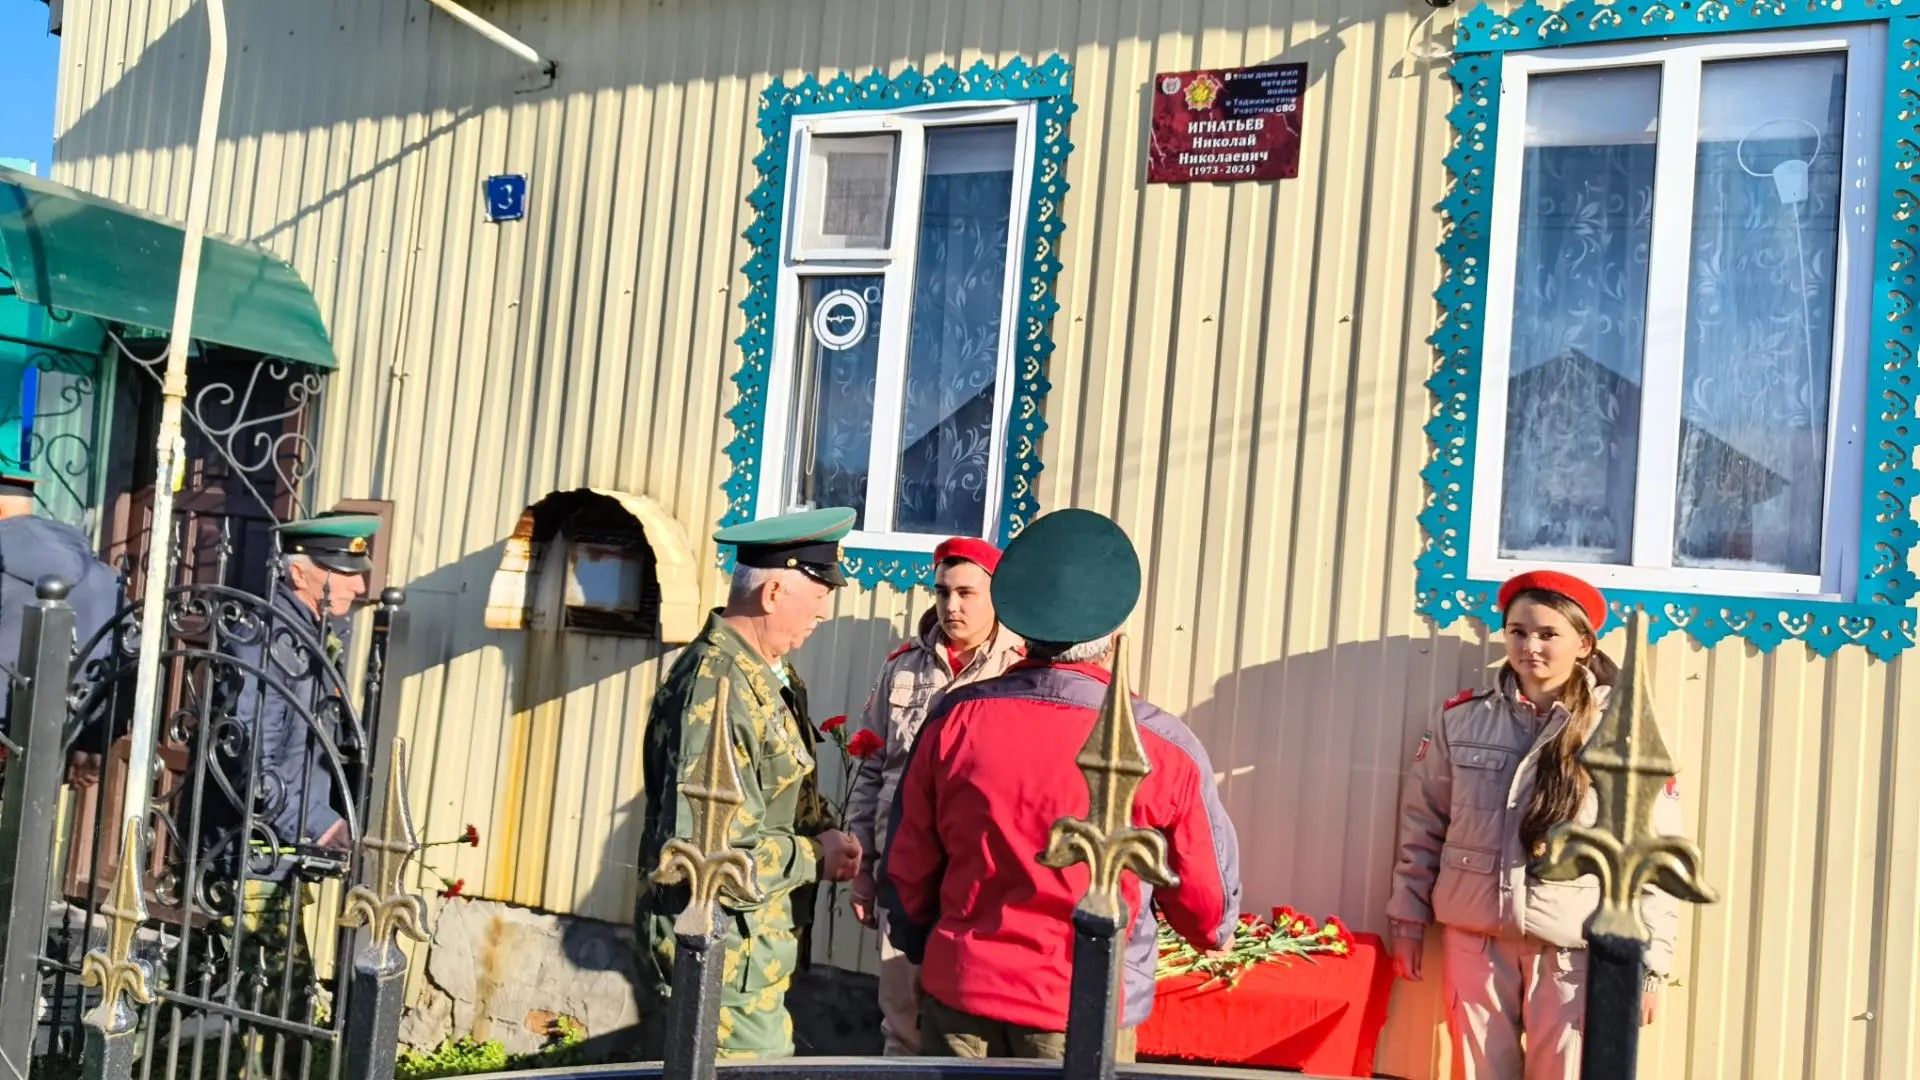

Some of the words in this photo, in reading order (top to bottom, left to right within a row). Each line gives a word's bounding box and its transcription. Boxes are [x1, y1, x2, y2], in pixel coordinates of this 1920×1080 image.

[1224, 72, 1232, 81] В
[1261, 79, 1298, 87] ветеран
[1233, 97, 1297, 106] Таджикистане
[1233, 106, 1275, 115] Участник
[1275, 103, 1297, 113] СВО
[1187, 117, 1265, 134] ИГНАТЬЕВ
[1192, 134, 1257, 149] Николай
[1178, 151, 1269, 165] Николаевич
[1189, 165, 1219, 177] (1973
[1225, 164, 1256, 175] 2024)
[498, 184, 514, 210] 3
